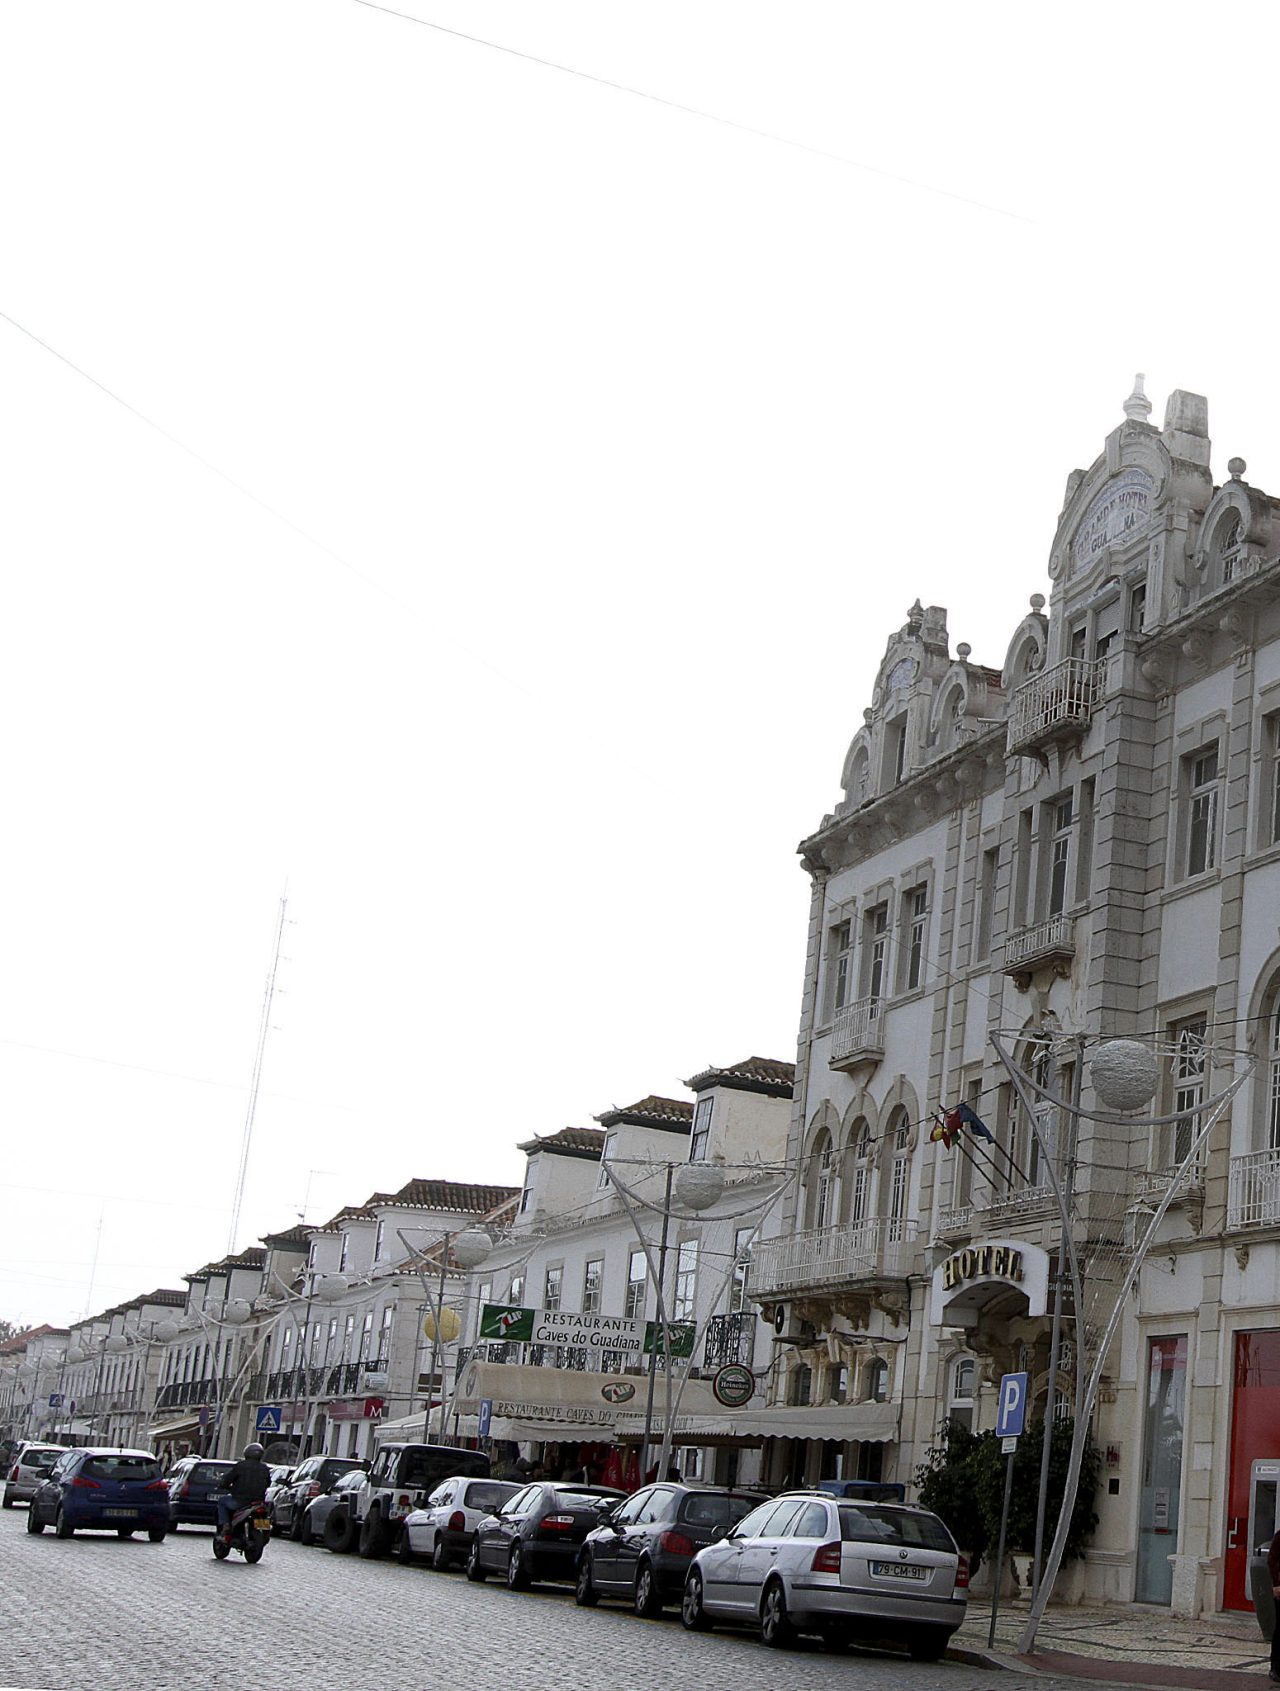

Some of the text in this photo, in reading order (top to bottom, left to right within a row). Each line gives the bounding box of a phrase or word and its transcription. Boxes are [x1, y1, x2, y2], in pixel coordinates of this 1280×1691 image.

[943, 1246, 1025, 1291] HOTEL
[544, 1313, 637, 1332] RESTAURANTE
[536, 1327, 640, 1351] Caves do Guadiana
[480, 1402, 488, 1431] P
[497, 1402, 562, 1418] RESTAURANTE
[566, 1409, 595, 1420] CAVES
[1002, 1380, 1020, 1430] P
